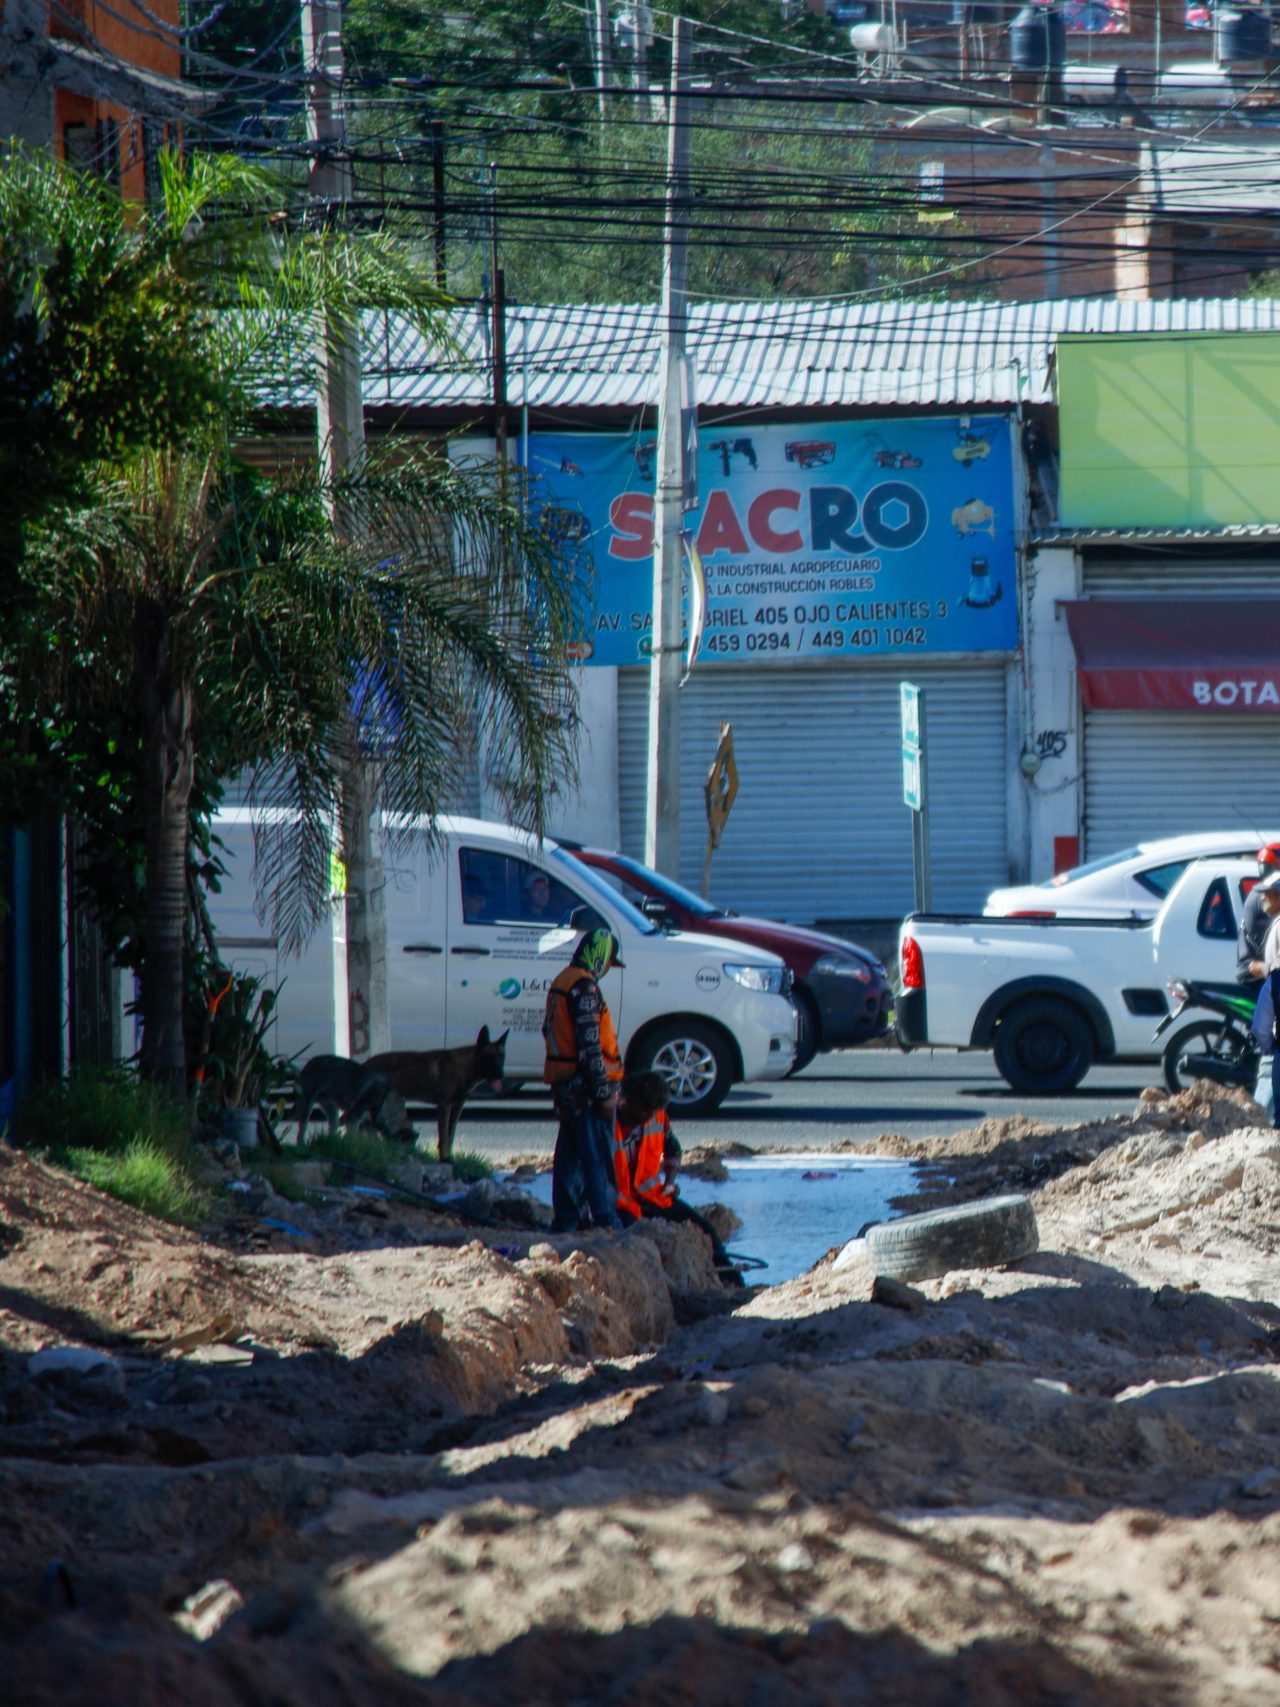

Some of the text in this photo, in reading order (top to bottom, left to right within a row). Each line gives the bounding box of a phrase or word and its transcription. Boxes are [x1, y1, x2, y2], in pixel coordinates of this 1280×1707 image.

[717, 561, 785, 577] INDUSTRIAL
[790, 558, 881, 575] AGROPECUARIO
[717, 582, 731, 596] LA
[735, 577, 826, 596] CONSTRUCCIÓN
[829, 577, 874, 592] ROBLES
[597, 612, 626, 632] AV.
[754, 606, 788, 627] 405
[794, 604, 831, 624] OJO
[836, 601, 931, 622] CALIENTES
[936, 600, 948, 618] 3
[707, 634, 740, 652] 459
[746, 631, 791, 651] 0294
[811, 629, 845, 648] 449
[850, 627, 879, 646] 401
[885, 626, 926, 645] 1042
[1037, 730, 1067, 756] 405
